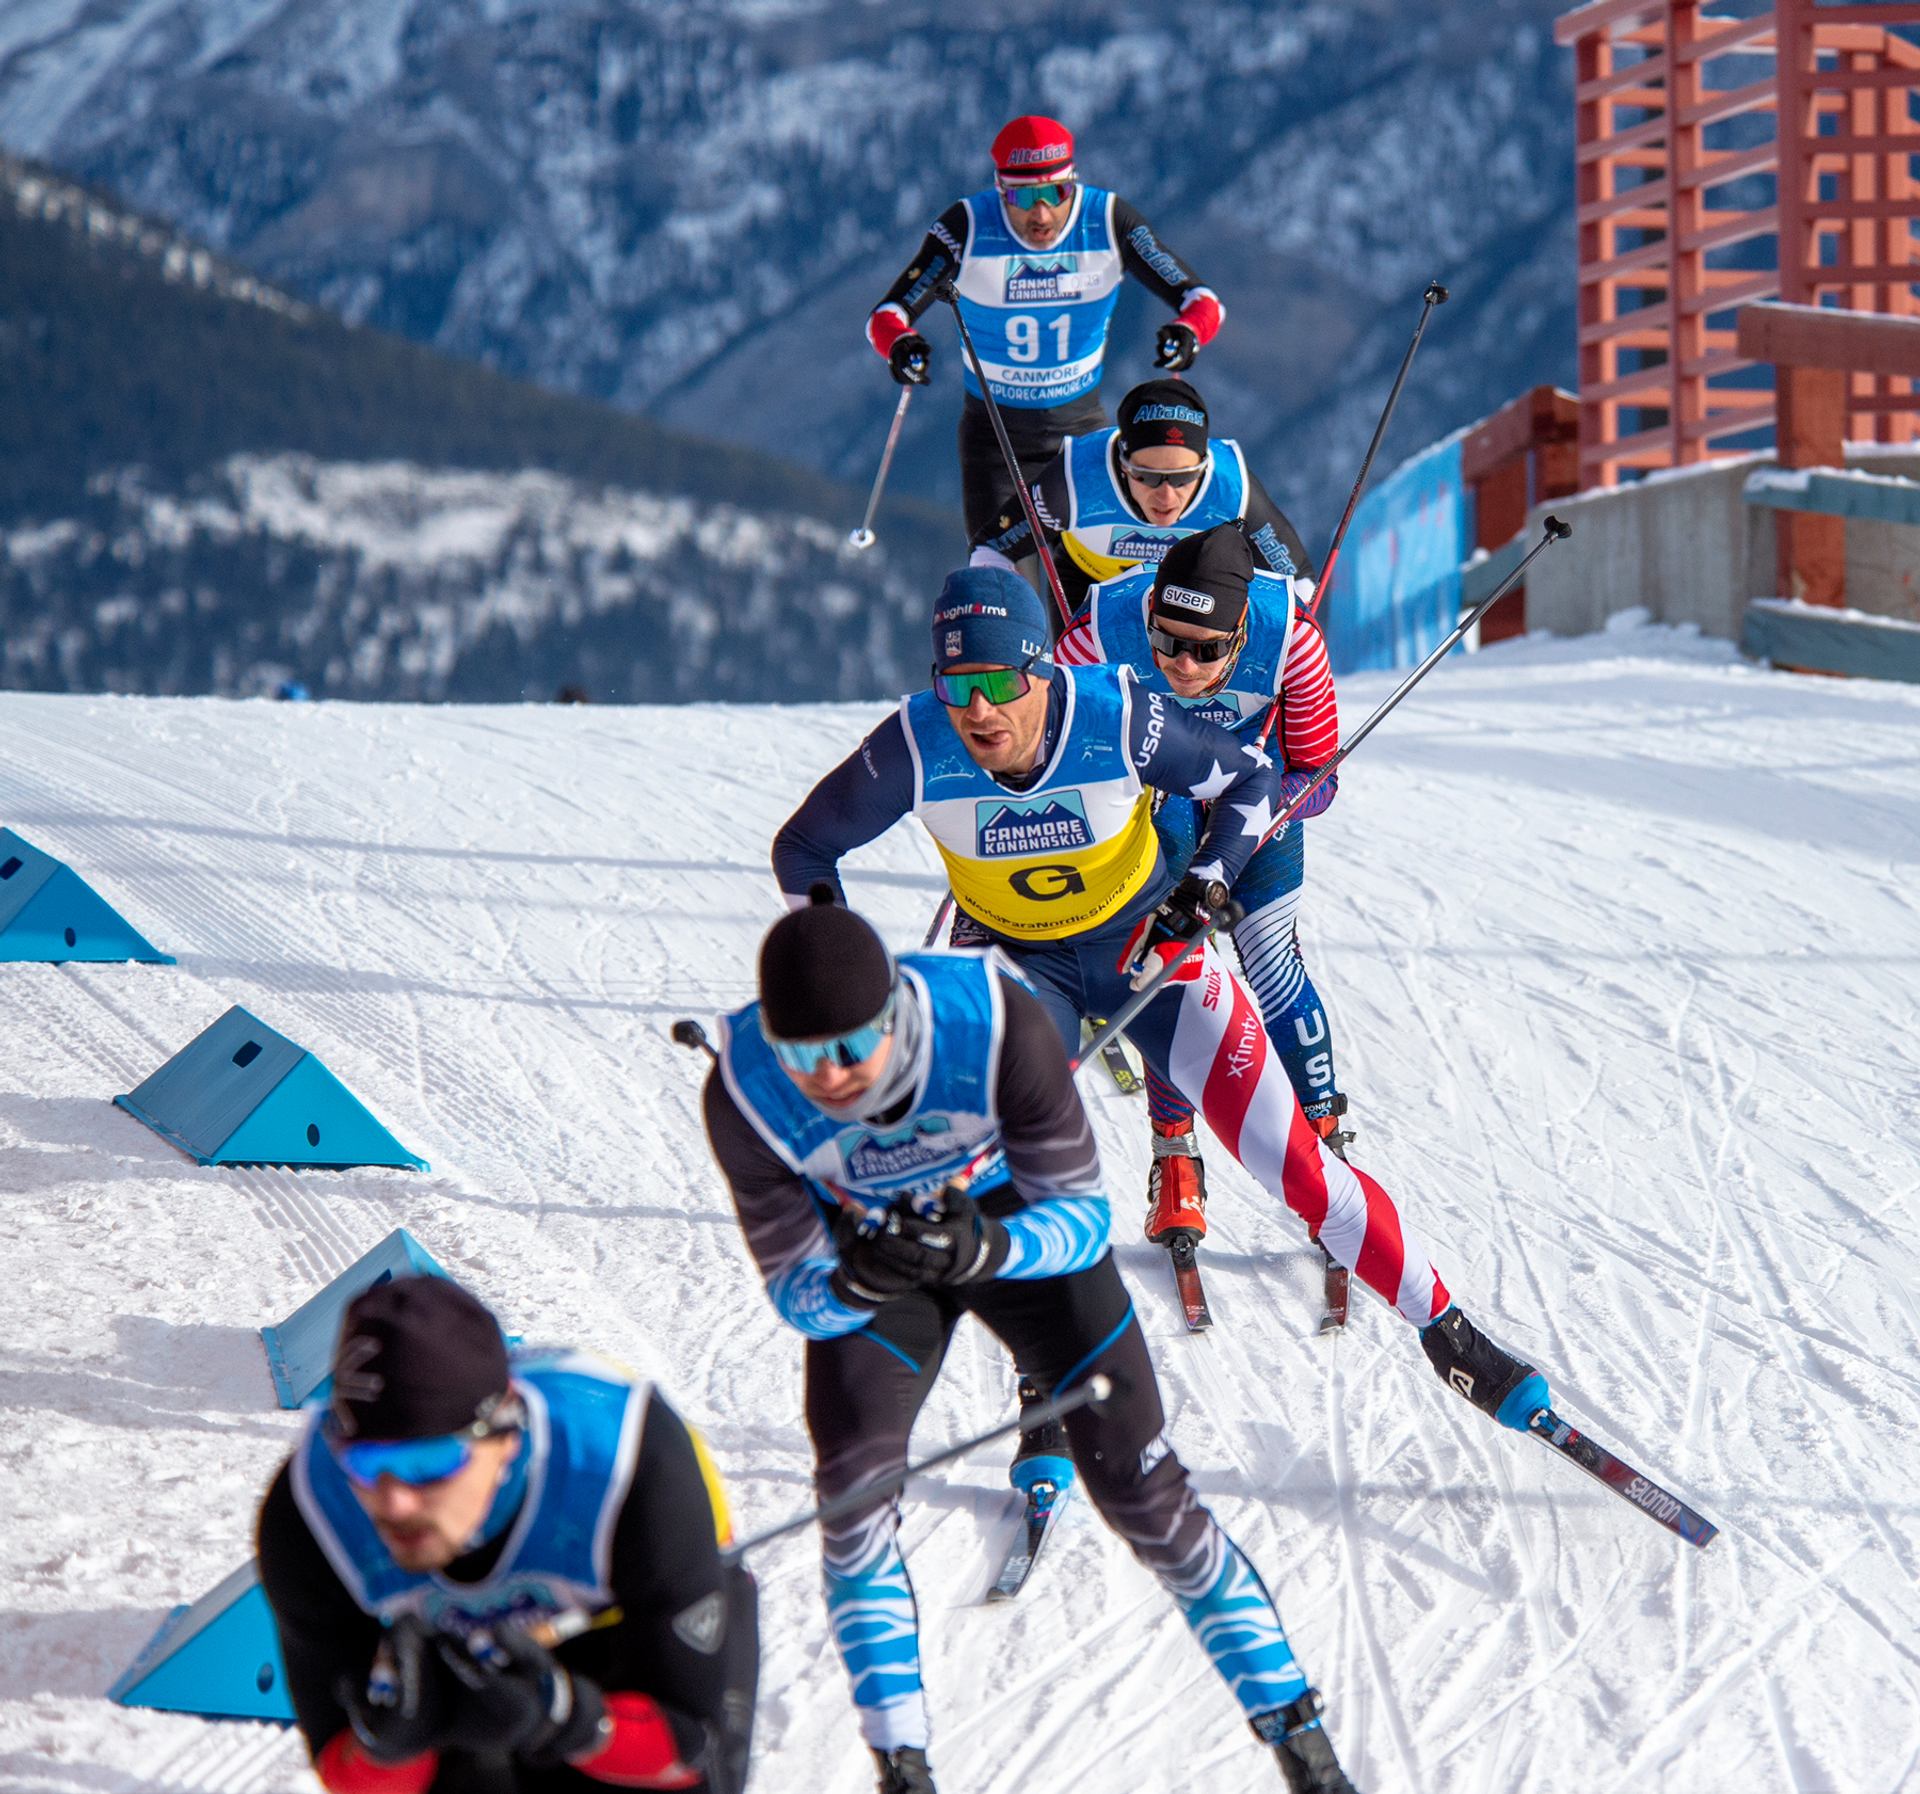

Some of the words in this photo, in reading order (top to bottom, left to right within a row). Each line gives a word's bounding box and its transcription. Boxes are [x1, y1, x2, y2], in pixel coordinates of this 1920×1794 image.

[1008, 143, 1068, 166] AltaGas
[1127, 225, 1188, 286] AltaGas
[1009, 277, 1056, 291] CANMO
[1005, 313, 1071, 362] 91
[988, 371, 1094, 401] XPLORECANMORE.CA
[1002, 365, 1080, 383] CANMORE
[1132, 403, 1205, 427] AltaGas
[1115, 541, 1170, 552] CANMO
[1134, 692, 1165, 767] USANA
[984, 818, 1081, 842] CANMORE
[985, 832, 1086, 854] KANANASKIS
[1008, 864, 1086, 902] G
[1226, 1010, 1259, 1079] xfinity
[1623, 1476, 1682, 1524] salomon
